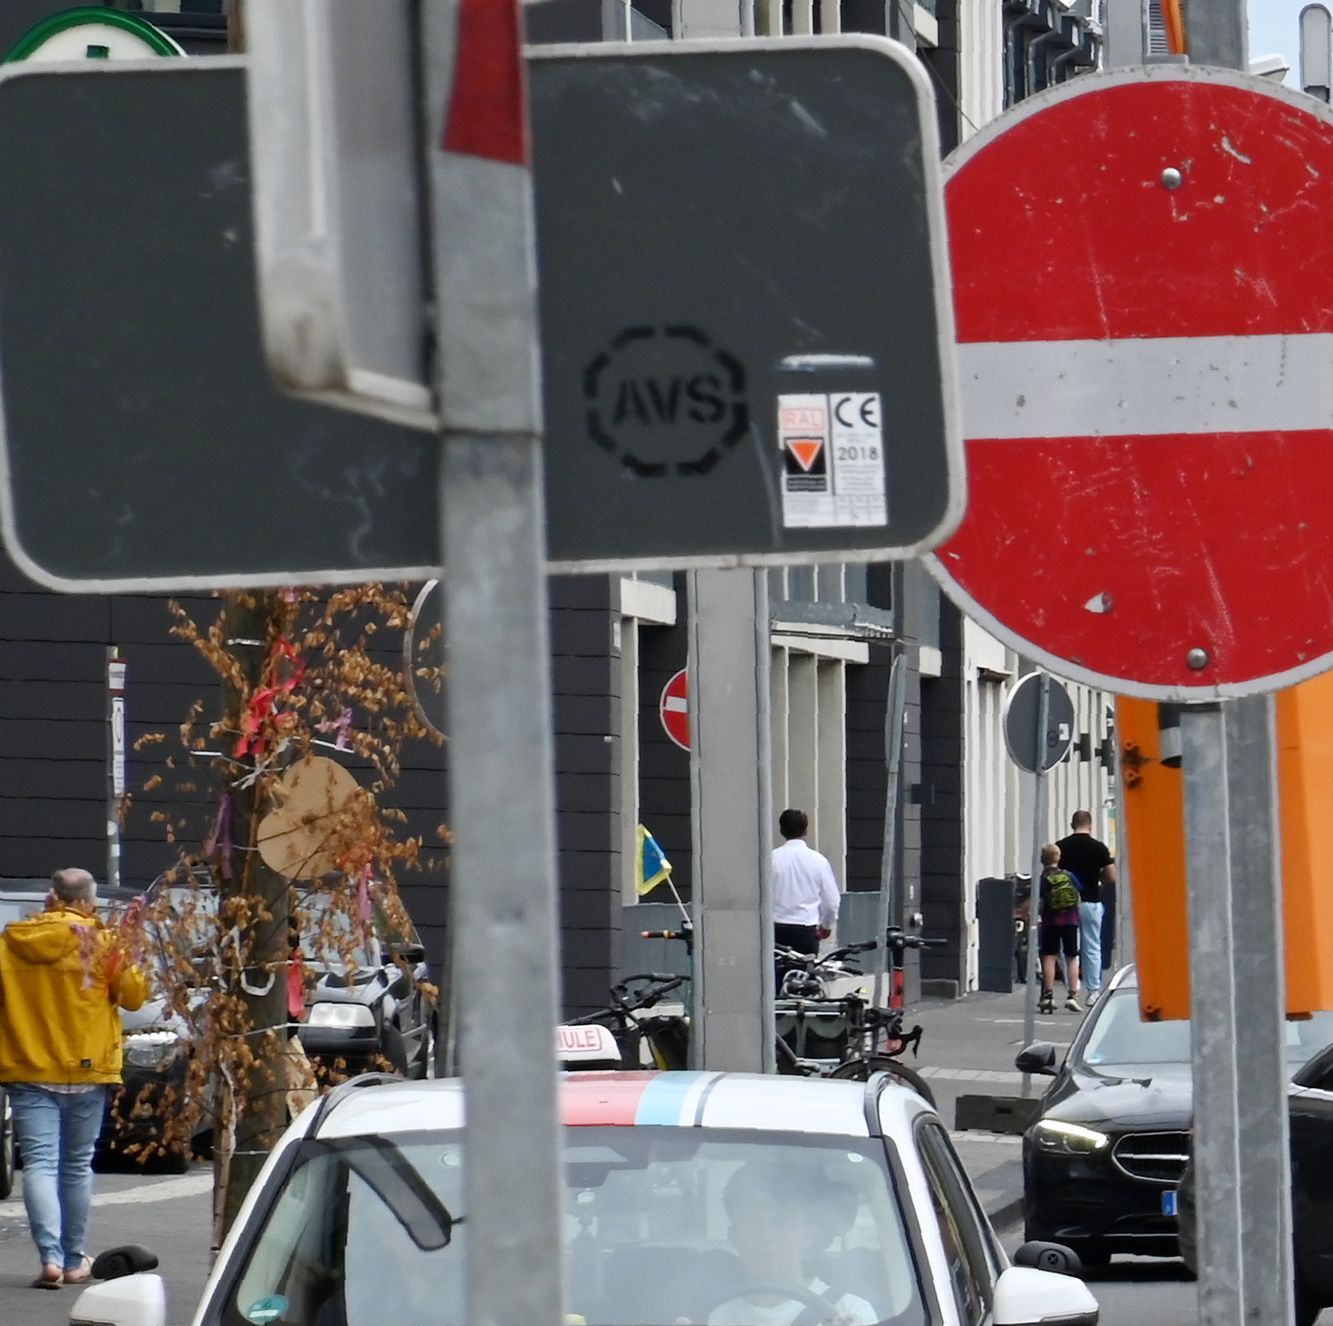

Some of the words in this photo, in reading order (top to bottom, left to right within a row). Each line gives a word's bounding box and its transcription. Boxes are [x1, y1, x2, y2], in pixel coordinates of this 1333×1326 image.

[612, 379, 727, 426] AVS
[784, 412, 822, 427] RAL
[837, 446, 879, 461] 2018
